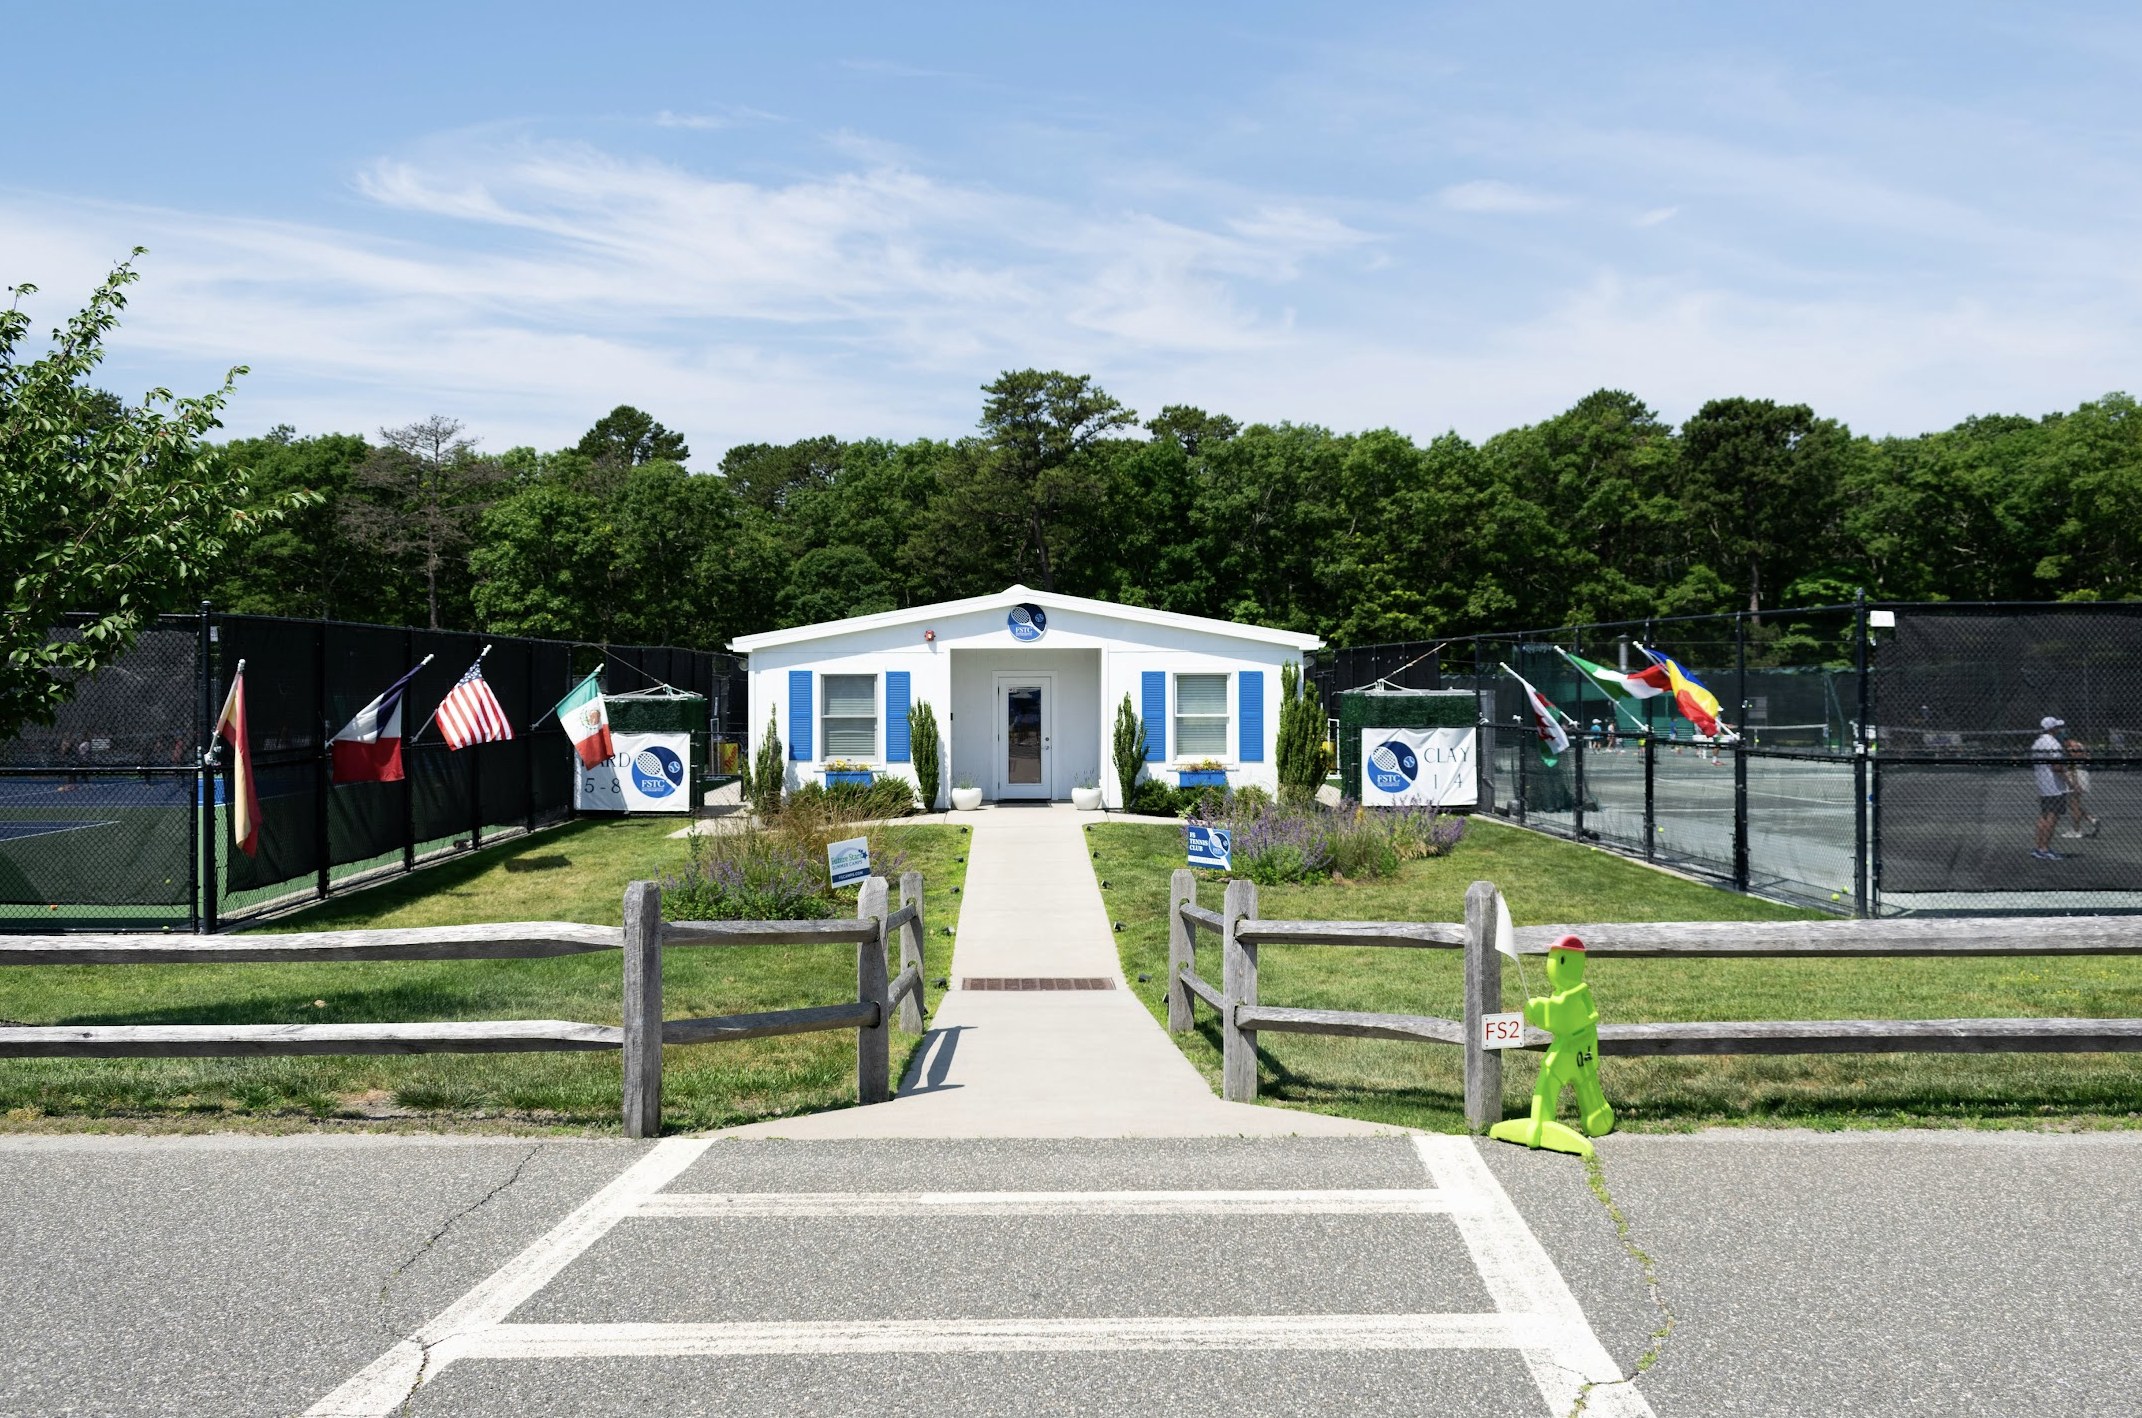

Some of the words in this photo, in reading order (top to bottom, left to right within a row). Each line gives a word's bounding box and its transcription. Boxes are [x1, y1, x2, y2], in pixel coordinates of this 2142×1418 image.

[1424, 747, 1470, 763] CLAY
[641, 779, 665, 788] FSTC
[1377, 774, 1401, 783] FSTC
[1454, 773, 1463, 788] 4
[584, 777, 595, 793] 5
[611, 777, 621, 794] 8
[1189, 838, 1209, 846] TENNIS
[1189, 844, 1204, 852] CLUB
[1485, 1021, 1520, 1040] FS2
